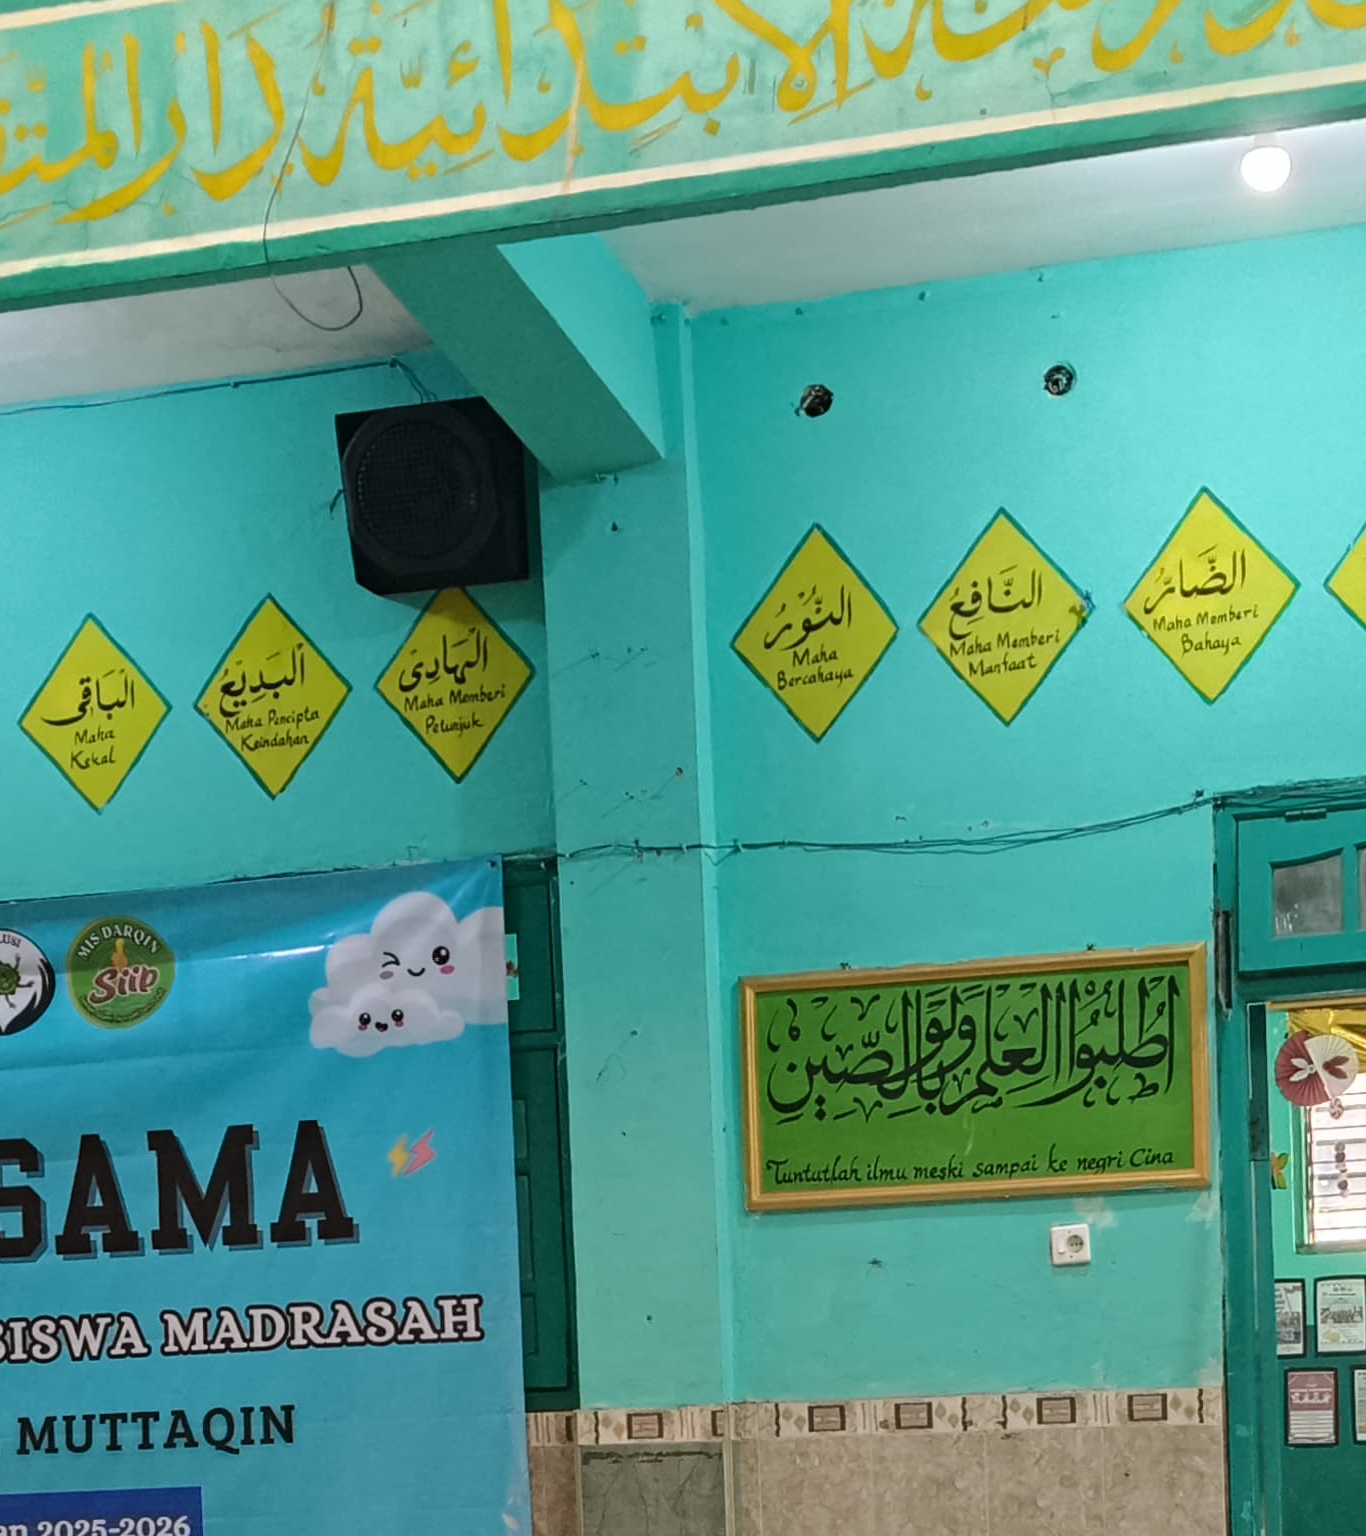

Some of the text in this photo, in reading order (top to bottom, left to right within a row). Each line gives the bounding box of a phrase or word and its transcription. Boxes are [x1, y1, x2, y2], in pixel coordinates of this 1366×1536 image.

[1152, 604, 1259, 633] Maha Memberi
[950, 629, 1061, 657] Maha Memberi
[1180, 633, 1242, 655] Bahaya
[792, 647, 838, 669] Maha
[776, 666, 854, 692] Bercahaya
[404, 684, 506, 712] Maha Memberi
[74, 726, 116, 746] Maha
[225, 713, 263, 734] Maha
[424, 712, 484, 738] Petunjuk
[77, 924, 159, 958] MIS DARQIN
[766, 1143, 1175, 1187] Tuntutlah ilmu meski sampai ke negri Cina
[160, 1294, 485, 1354] MADRASAH
[17, 1404, 295, 1457] MUTTAQIN
